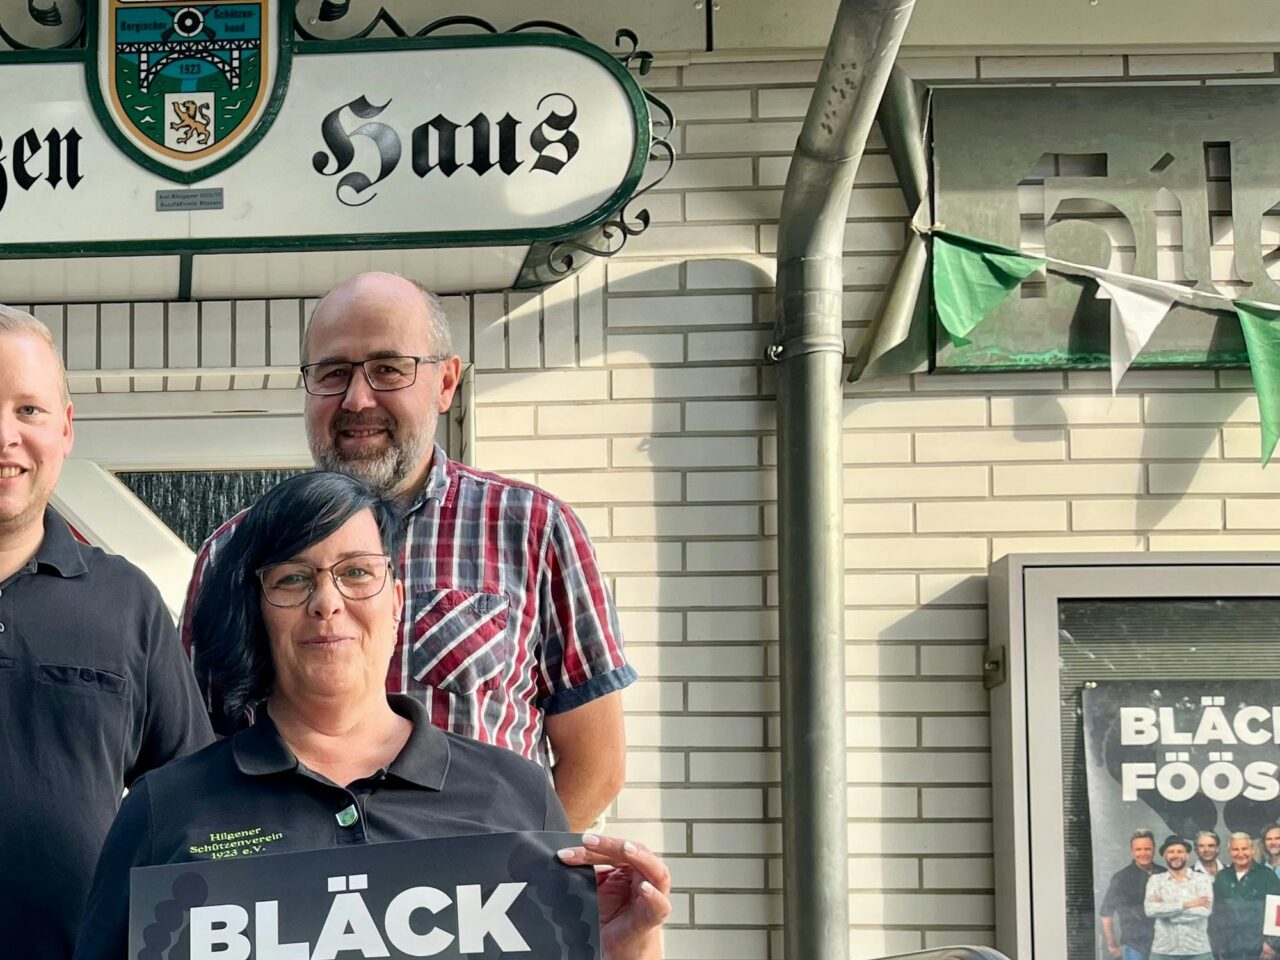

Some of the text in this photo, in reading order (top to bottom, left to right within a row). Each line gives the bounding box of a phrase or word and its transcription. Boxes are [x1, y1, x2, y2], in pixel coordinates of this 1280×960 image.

[179, 64, 201, 74] 1923
[312, 92, 579, 206] Haus
[1120, 696, 1280, 745] BLÄC
[189, 832, 283, 854] Schützenverein
[210, 828, 261, 842] Hilgener
[211, 845, 265, 860] 1923 e.V.
